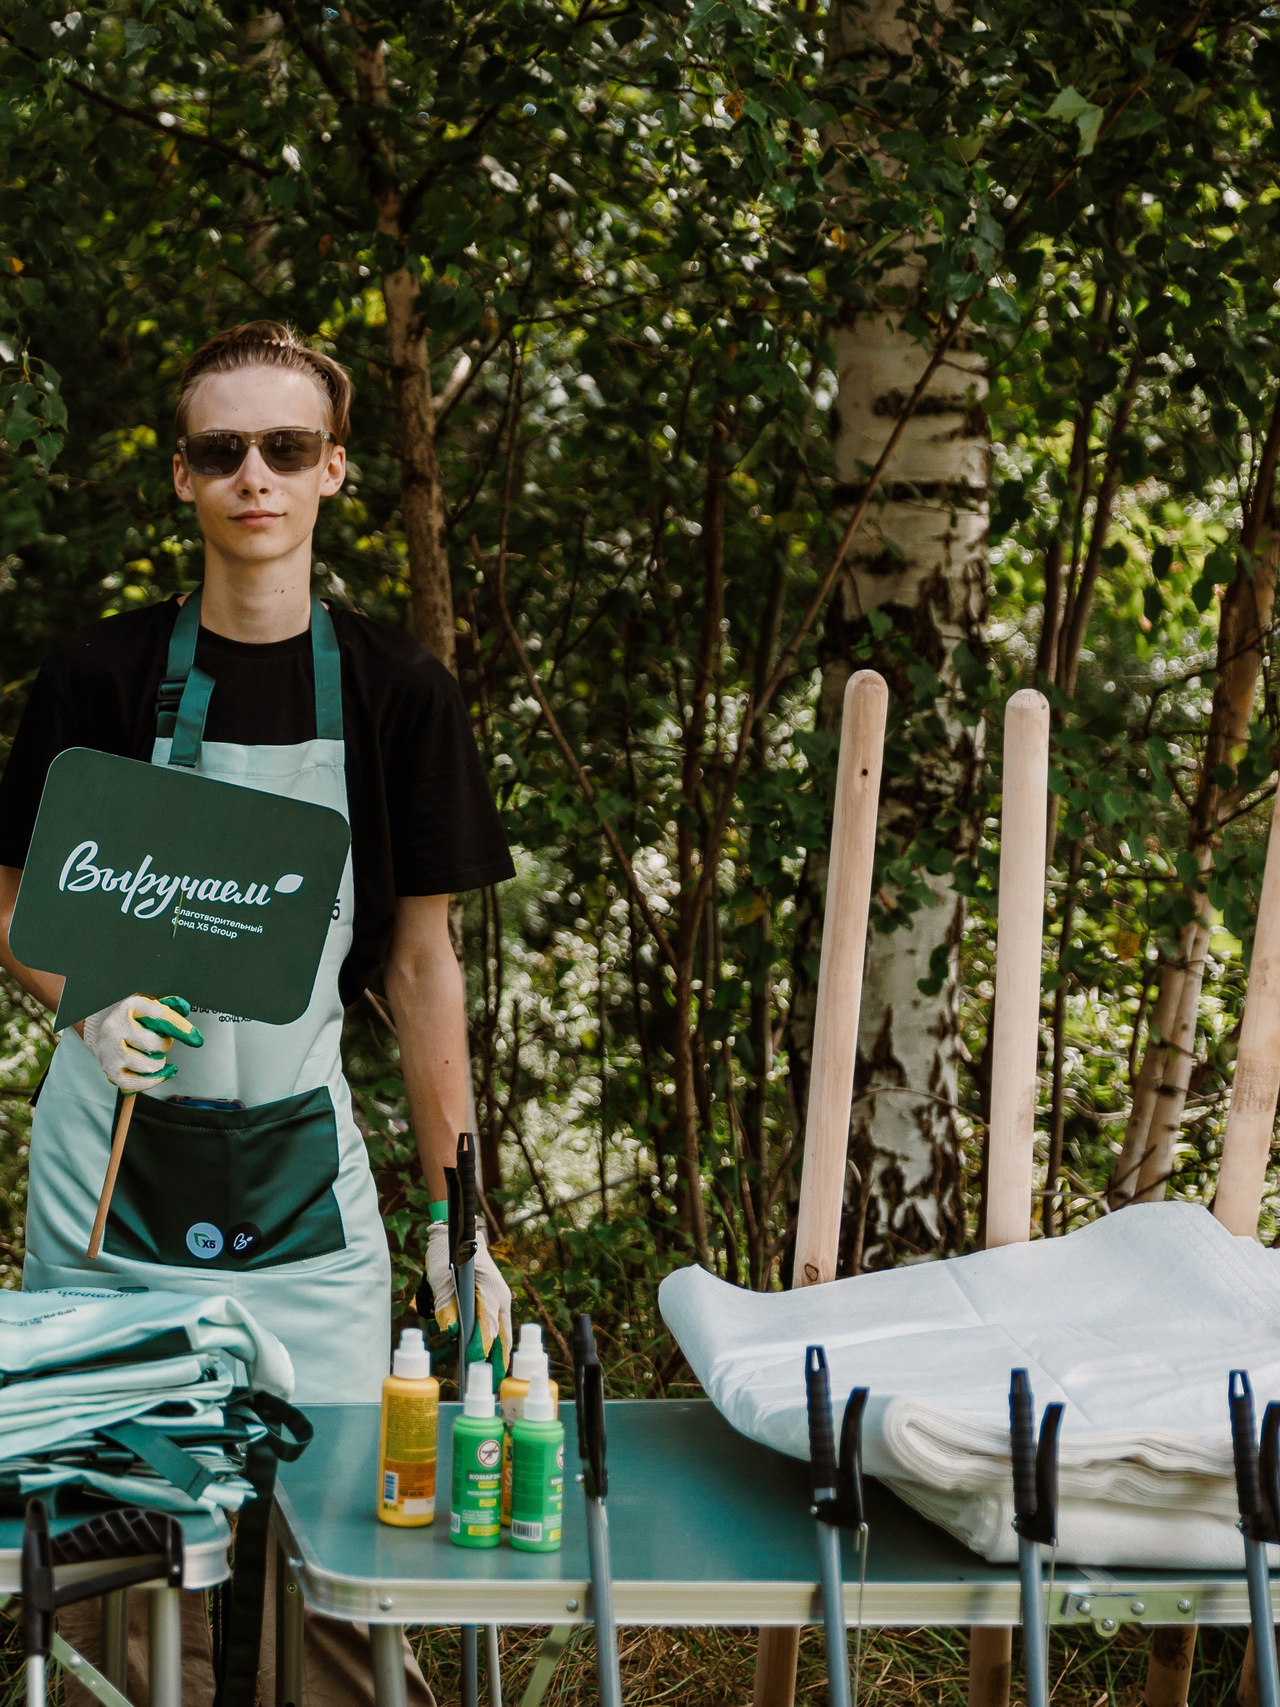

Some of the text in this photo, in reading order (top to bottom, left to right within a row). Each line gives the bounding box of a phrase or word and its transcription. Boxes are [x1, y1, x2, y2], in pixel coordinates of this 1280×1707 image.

[59, 840, 271, 919] Выручаем
[174, 906, 263, 934] Благотворительный
[196, 922, 209, 932] X5
[210, 925, 238, 940] Group
[202, 1239, 216, 1249] X5
